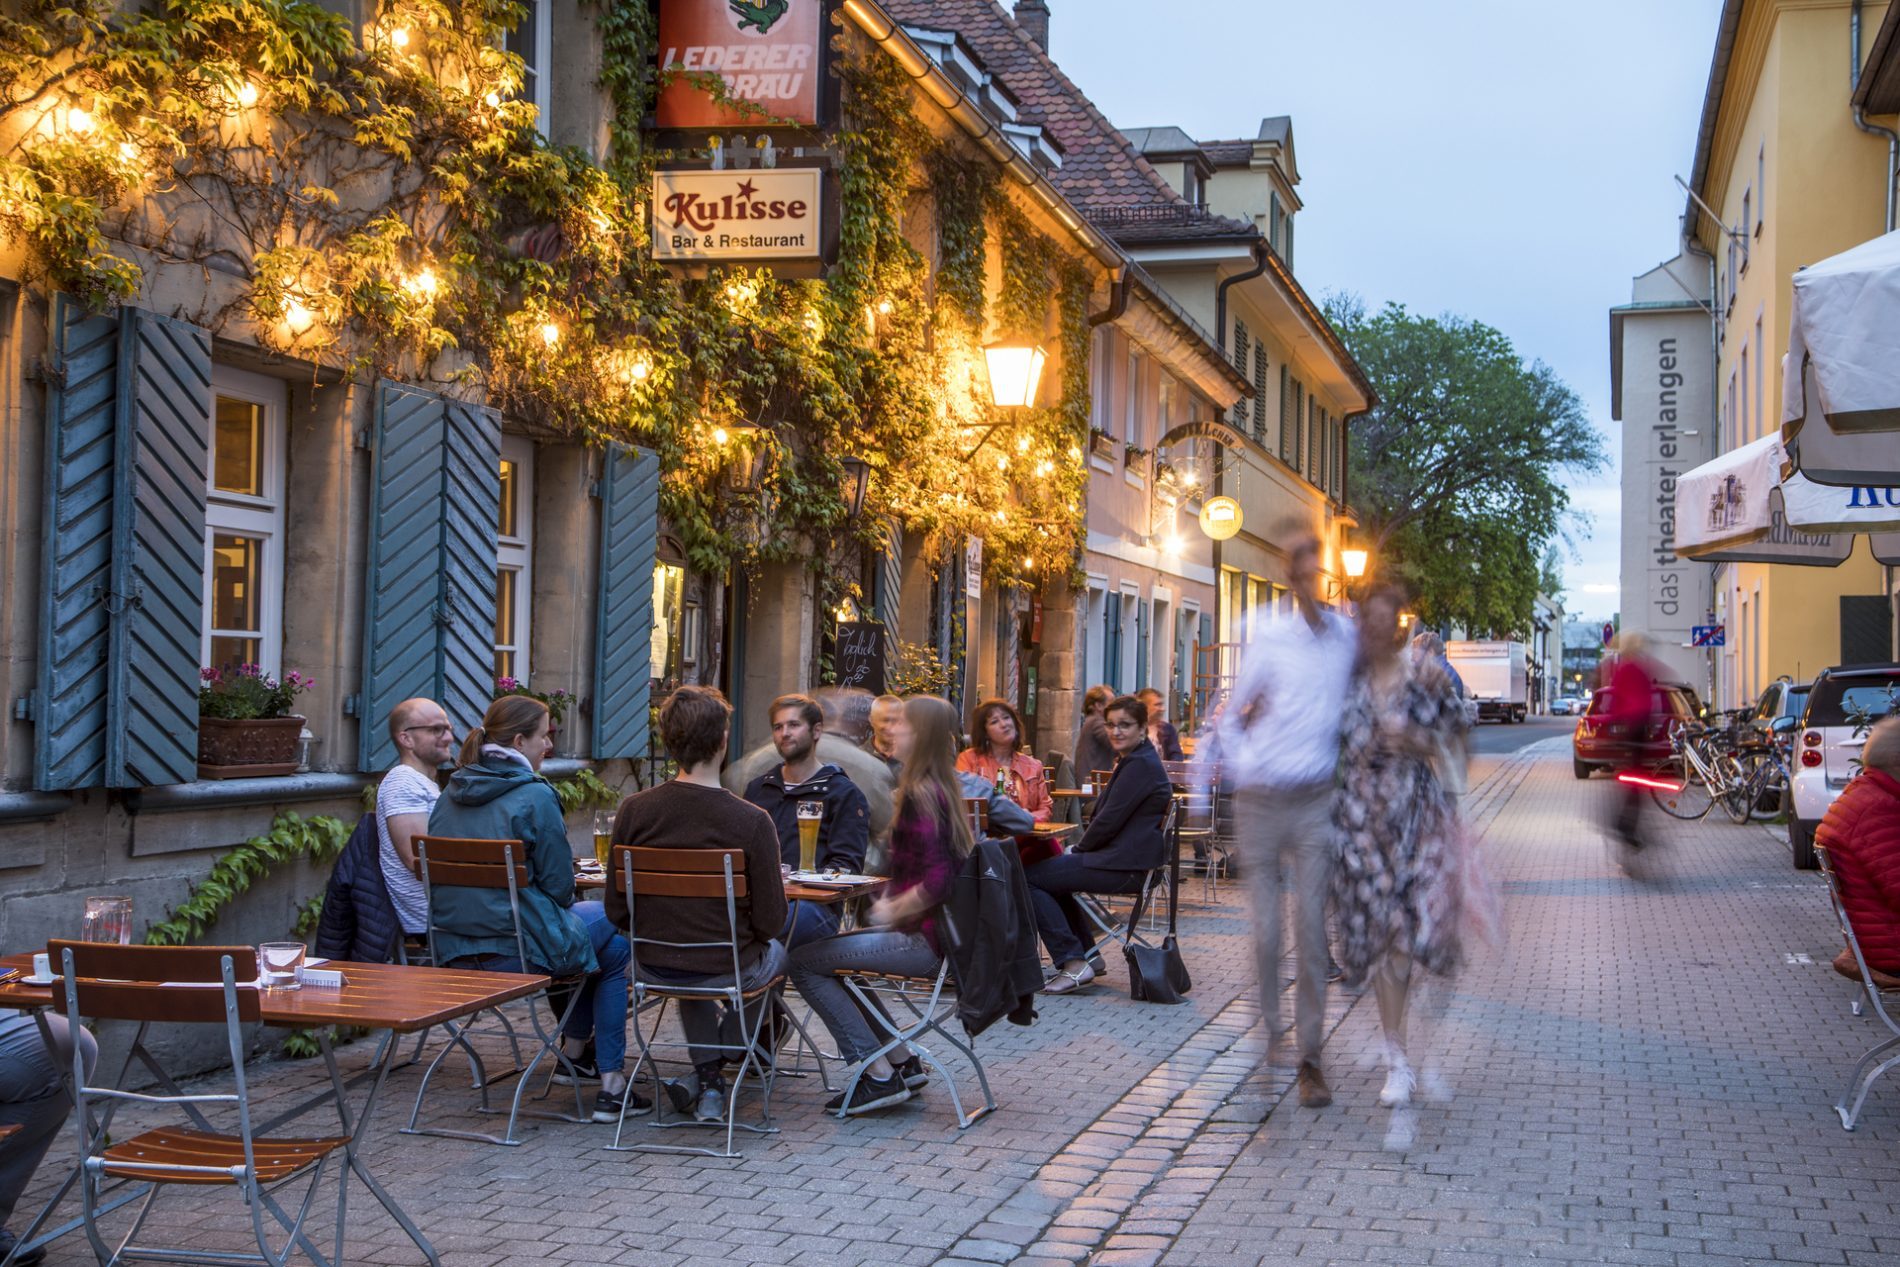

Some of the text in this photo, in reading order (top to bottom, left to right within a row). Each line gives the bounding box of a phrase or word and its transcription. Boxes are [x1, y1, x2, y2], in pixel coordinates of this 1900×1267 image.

[662, 43, 813, 72] LEDERER
[664, 179, 807, 232] Kulisse
[672, 233, 805, 248] Bar & Restaurant
[1653, 337, 1684, 616] das theater erlangen
